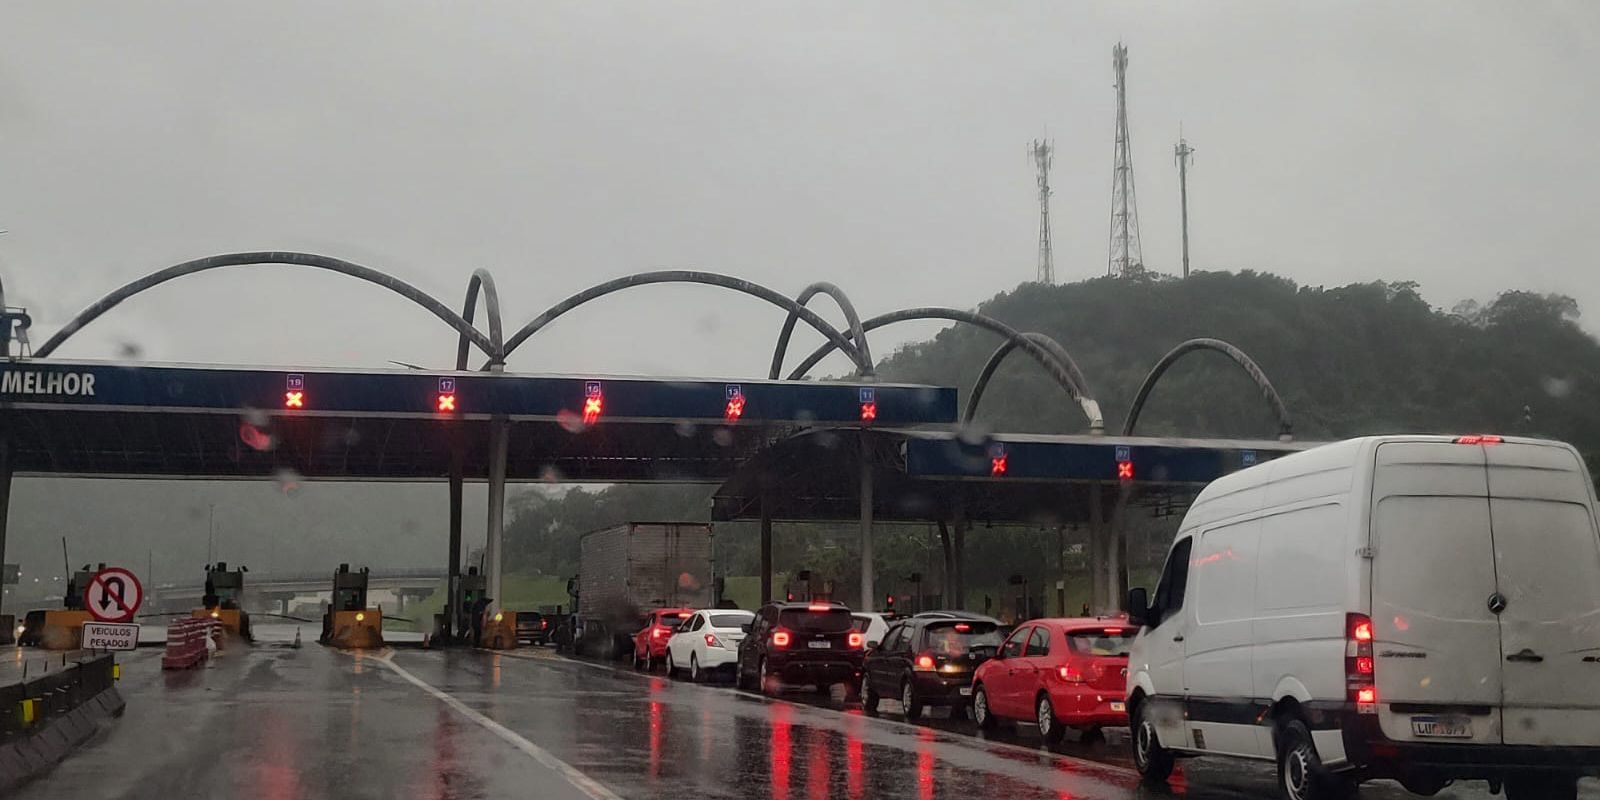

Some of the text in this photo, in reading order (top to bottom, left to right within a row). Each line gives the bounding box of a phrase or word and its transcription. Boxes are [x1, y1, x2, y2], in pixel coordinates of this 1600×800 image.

[1, 370, 96, 396] MELHOR
[440, 380, 453, 390] 17
[91, 626, 132, 637] VEICULOS
[90, 638, 129, 648] PESADOS
